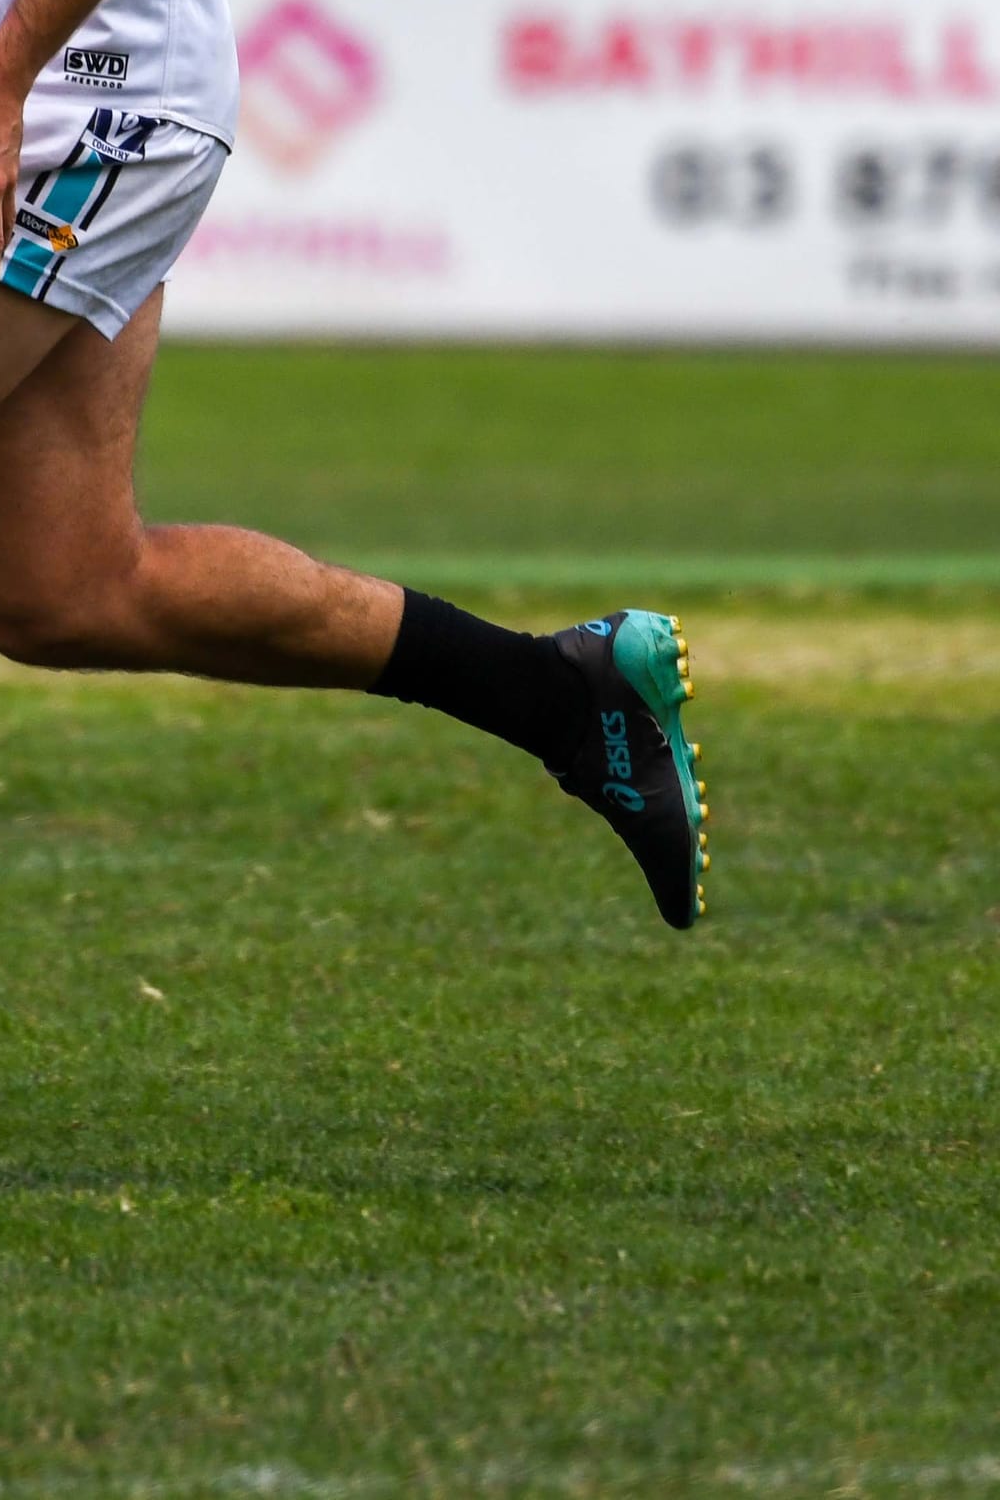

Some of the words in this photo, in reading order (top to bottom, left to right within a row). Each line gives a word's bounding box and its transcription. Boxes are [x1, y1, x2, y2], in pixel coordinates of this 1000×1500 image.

[68, 52, 125, 76] SWD
[65, 74, 123, 90] SHERWOOD
[91, 137, 131, 162] COUNTRY
